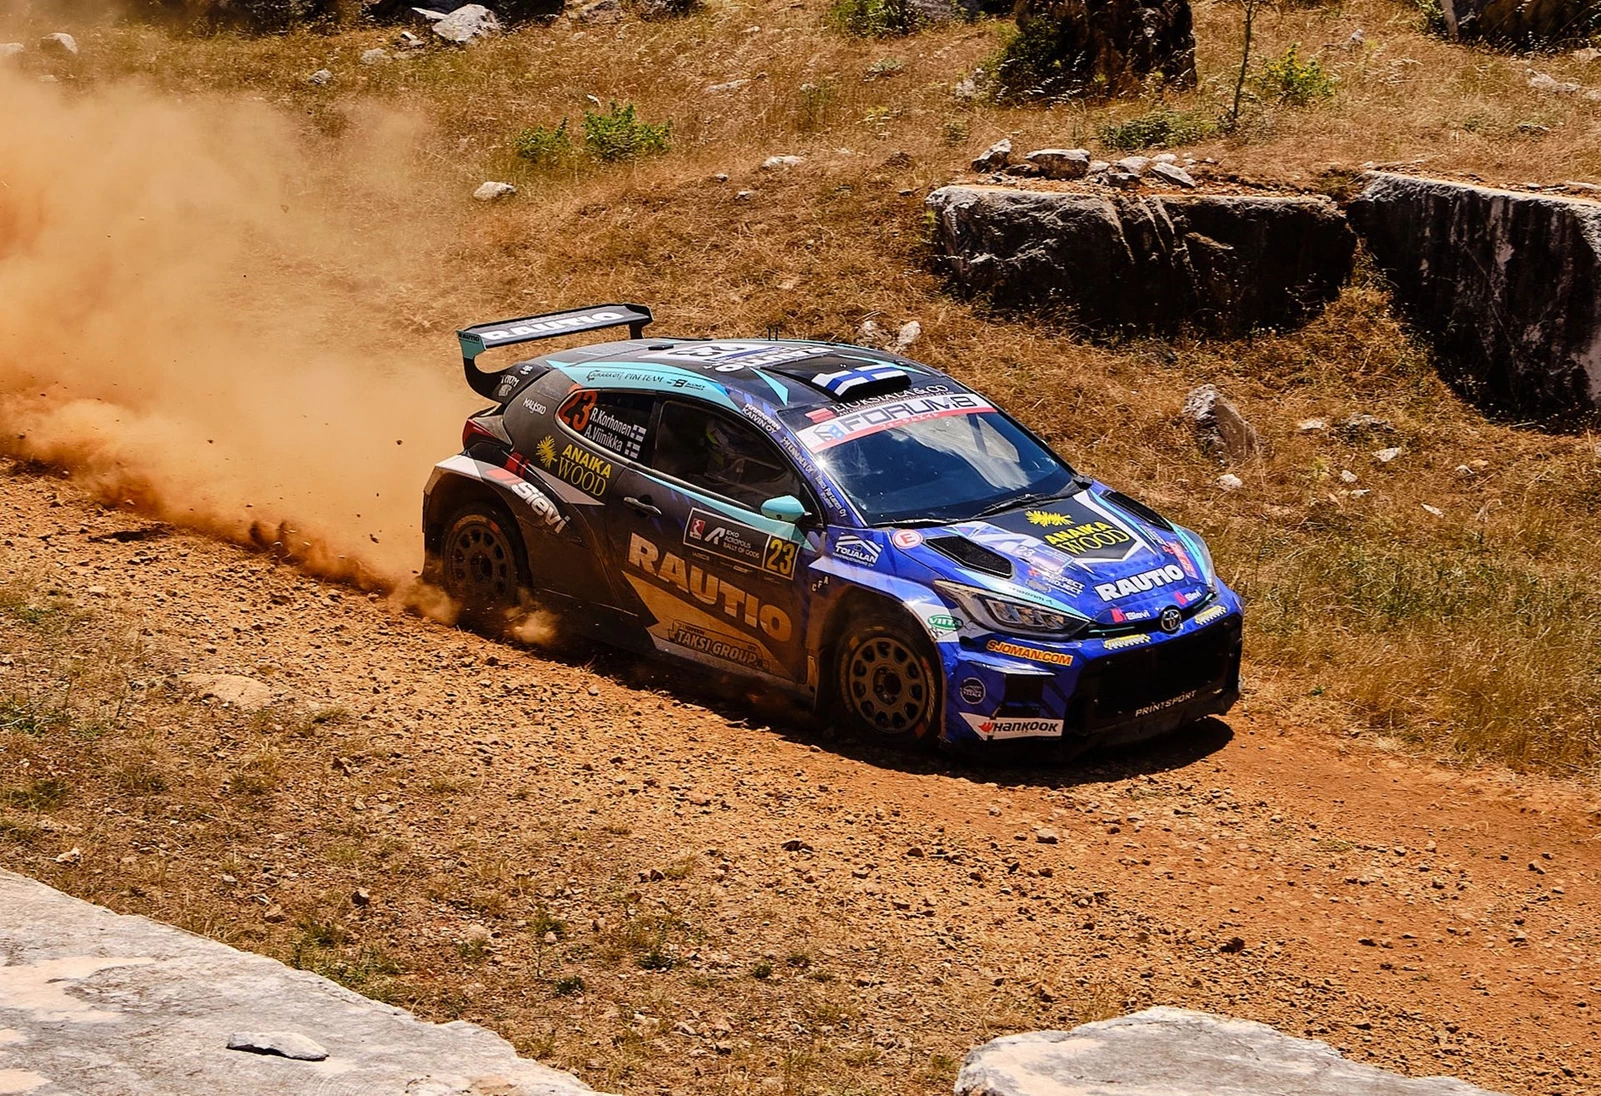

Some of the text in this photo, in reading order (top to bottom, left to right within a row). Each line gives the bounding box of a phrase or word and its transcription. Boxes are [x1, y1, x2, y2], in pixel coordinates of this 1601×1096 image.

[481, 312, 624, 341] RAUTIO
[558, 384, 598, 431] 23
[589, 407, 632, 437] R.Korhonen
[838, 396, 977, 431] FORUM8
[583, 424, 623, 452] A.Viinikka
[562, 444, 612, 478] ANAIKA
[558, 457, 607, 497] WOOD
[511, 481, 571, 534] Sievi
[724, 536, 751, 549] ACROPOLIS
[726, 529, 740, 538] EKO
[1044, 521, 1113, 545] ANAIKA
[1056, 529, 1130, 555] WOOD
[722, 542, 760, 559] RALLY OF GODS
[766, 539, 796, 575] 23
[1017, 545, 1034, 557] 23
[628, 532, 792, 642] RAUTIO
[1094, 564, 1185, 602] RAUTIO
[676, 629, 759, 664] TAKSI GROUP
[986, 640, 1074, 667] SJOMAN.COM
[1135, 690, 1197, 717] PRINTSPORT
